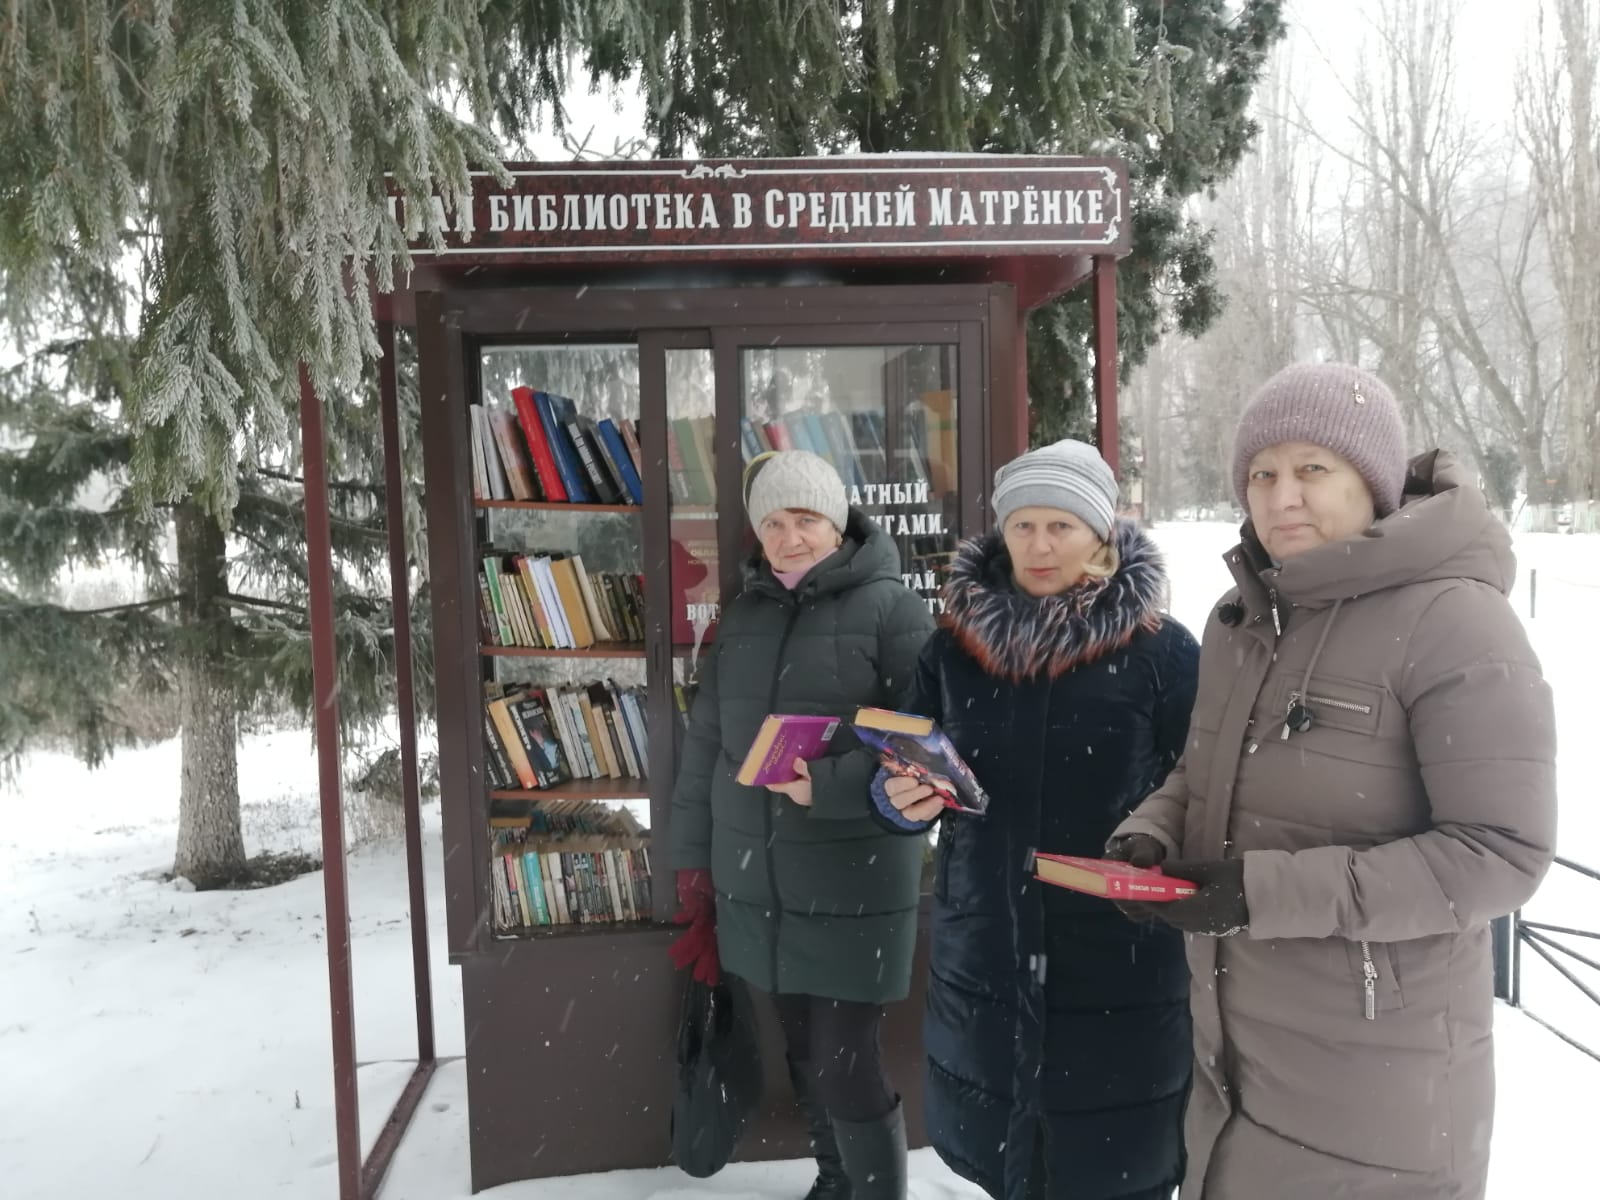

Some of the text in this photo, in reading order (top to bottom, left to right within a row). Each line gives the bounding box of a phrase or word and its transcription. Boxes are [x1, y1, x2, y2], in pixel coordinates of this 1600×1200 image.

[488, 192, 721, 232] БИБЛИОТЕКА
[732, 192, 752, 229] В
[927, 186, 1104, 228] МАТРЁНКЕ
[843, 479, 928, 505] АТНЫЙ
